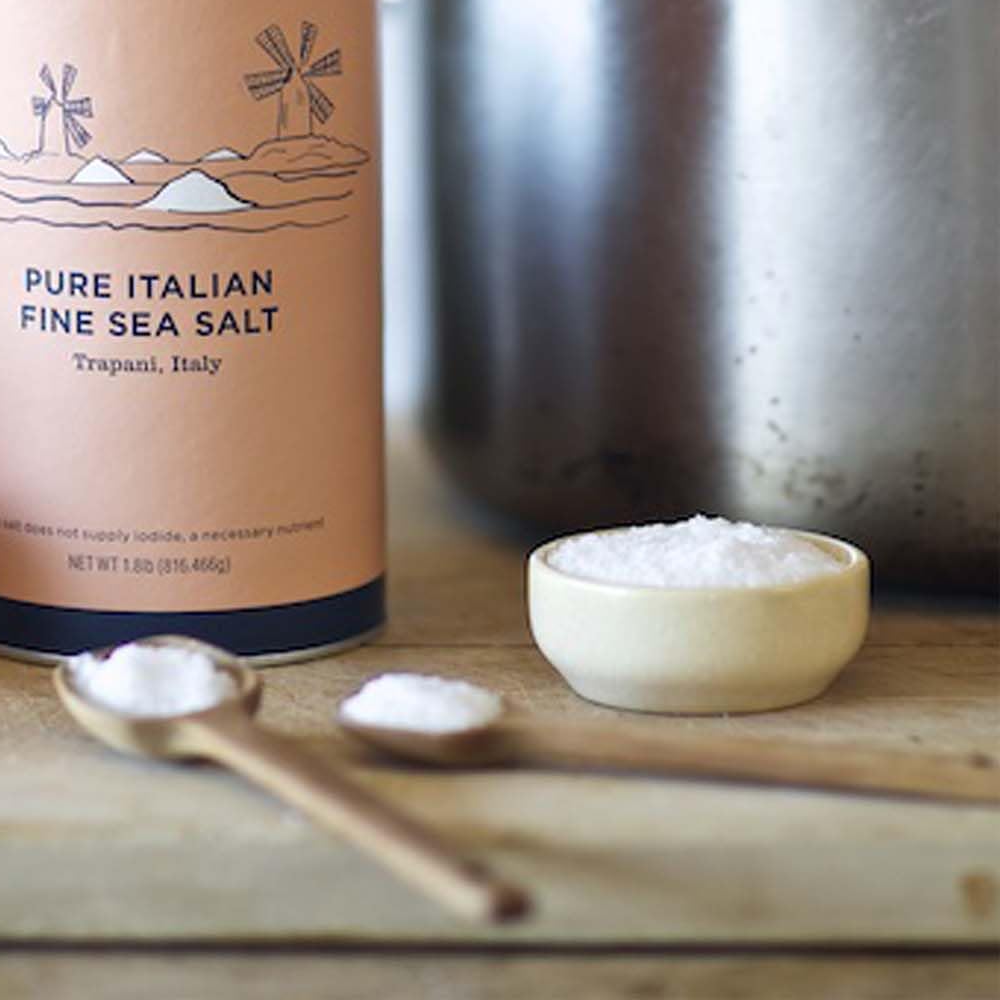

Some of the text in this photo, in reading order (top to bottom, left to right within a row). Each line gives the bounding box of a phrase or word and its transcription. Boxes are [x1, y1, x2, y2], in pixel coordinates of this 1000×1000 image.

[24, 267, 275, 300] PURE ITALIAN
[19, 304, 280, 338] FINE SEA SALT
[72, 353, 223, 376] Trapani, Italy
[23, 522, 53, 537] does
[56, 527, 80, 540] not
[82, 529, 131, 544] supply
[133, 529, 187, 543] iodide,
[189, 531, 199, 542] a
[201, 526, 274, 541] necessary
[67, 553, 94, 571] NET
[96, 555, 119, 572] WT
